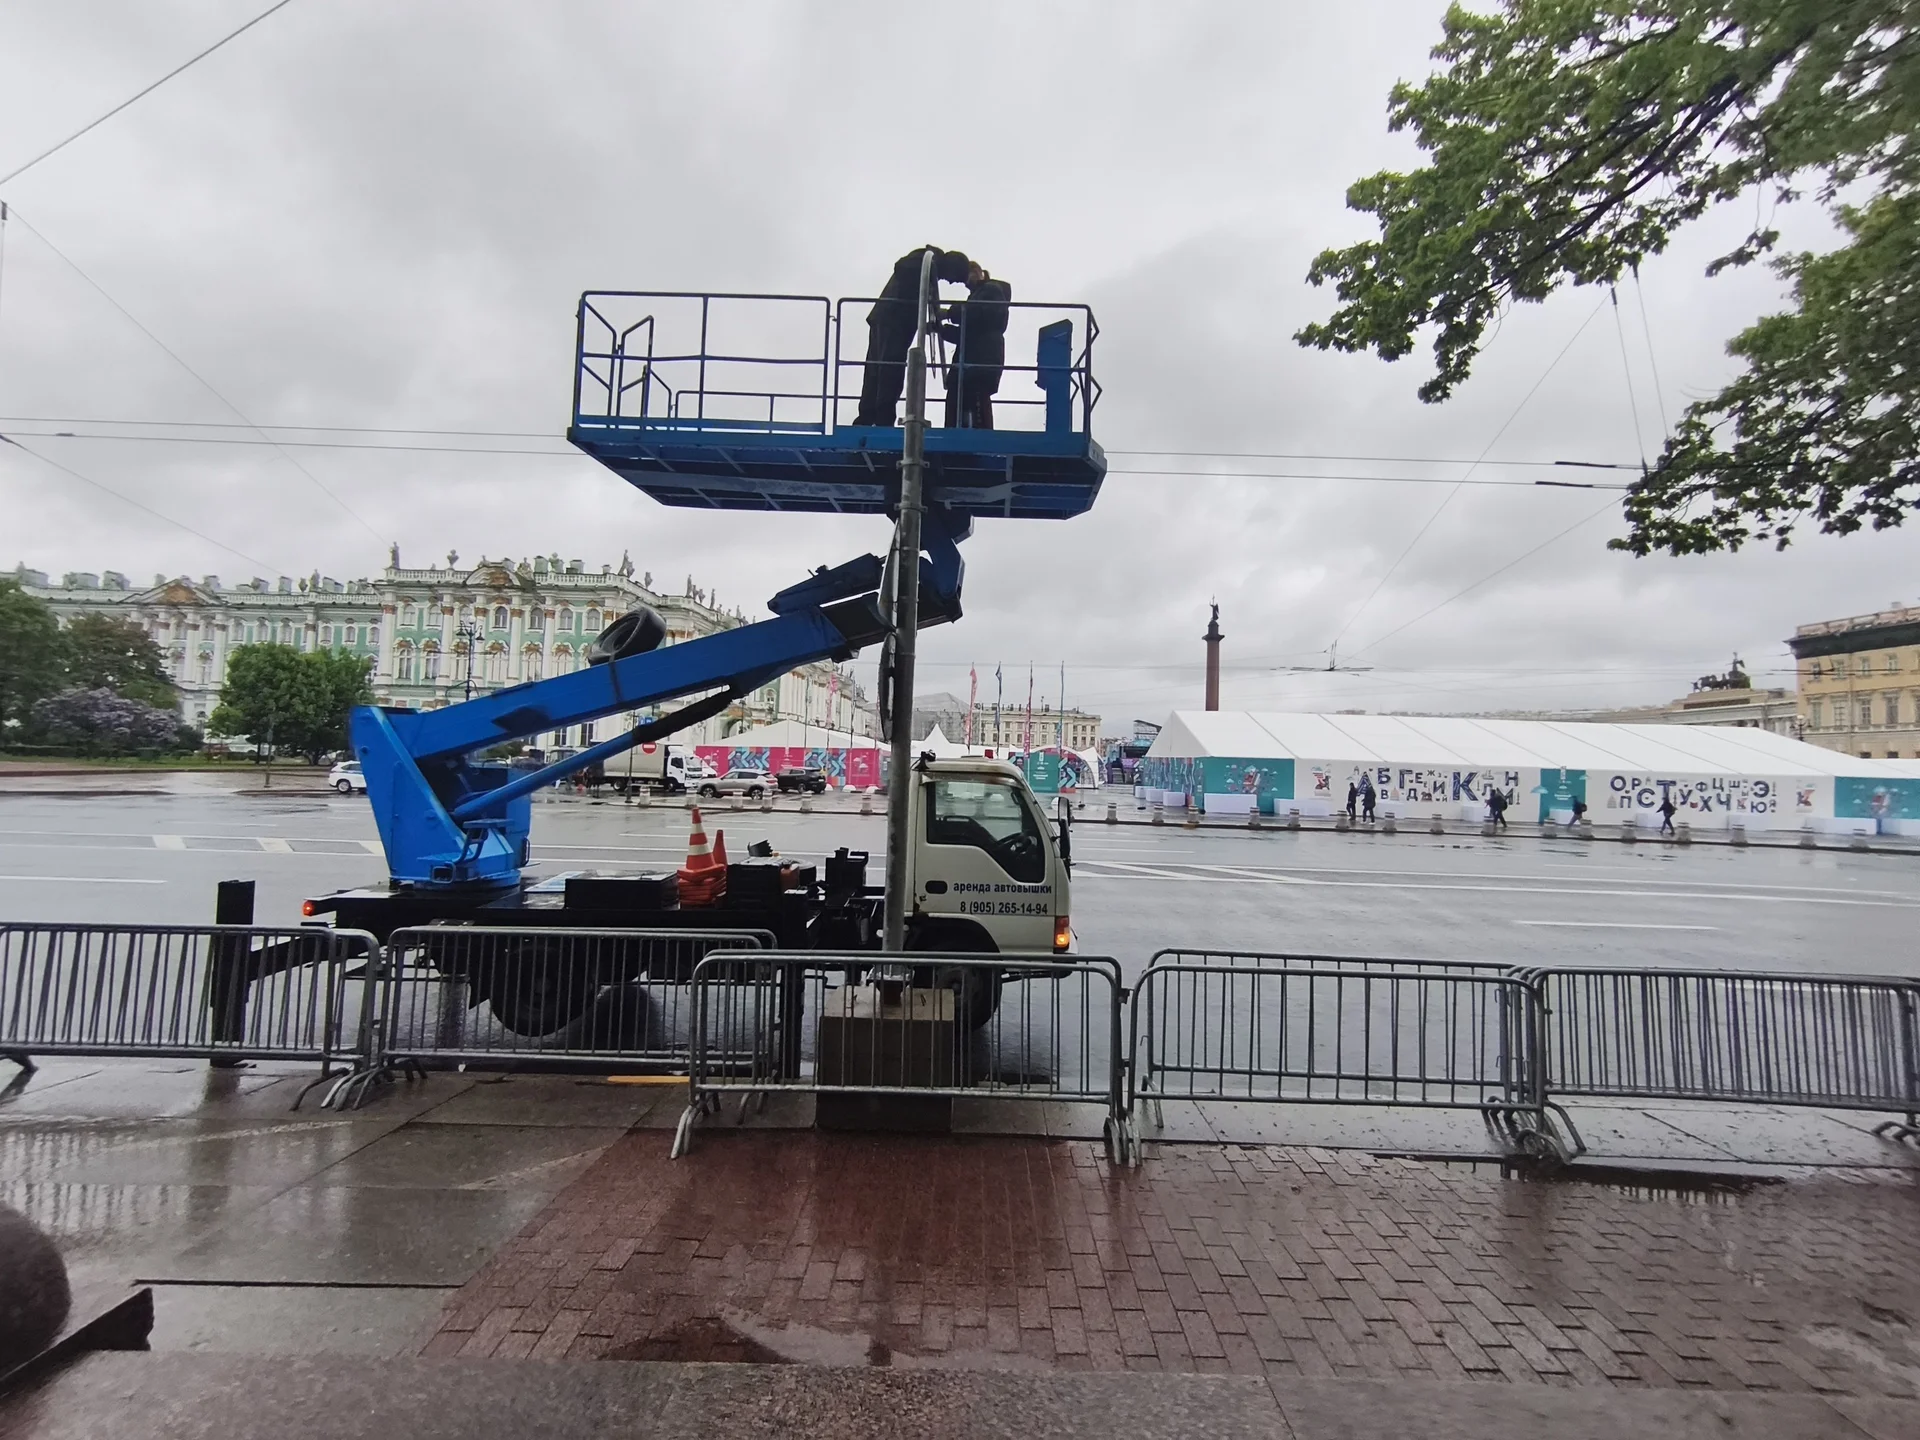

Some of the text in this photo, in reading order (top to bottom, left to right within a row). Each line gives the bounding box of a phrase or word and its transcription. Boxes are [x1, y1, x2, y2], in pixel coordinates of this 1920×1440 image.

[1378, 768, 1391, 784] Б
[1399, 769, 1413, 788] Г
[1452, 772, 1478, 800] К
[1505, 771, 1518, 786] Н
[1610, 776, 1626, 791] О
[1753, 780, 1769, 798] Э
[1637, 788, 1655, 808] С
[953, 883, 1052, 894] аренда автовышки
[960, 901, 1048, 914] 8 (905) 265-14-94
